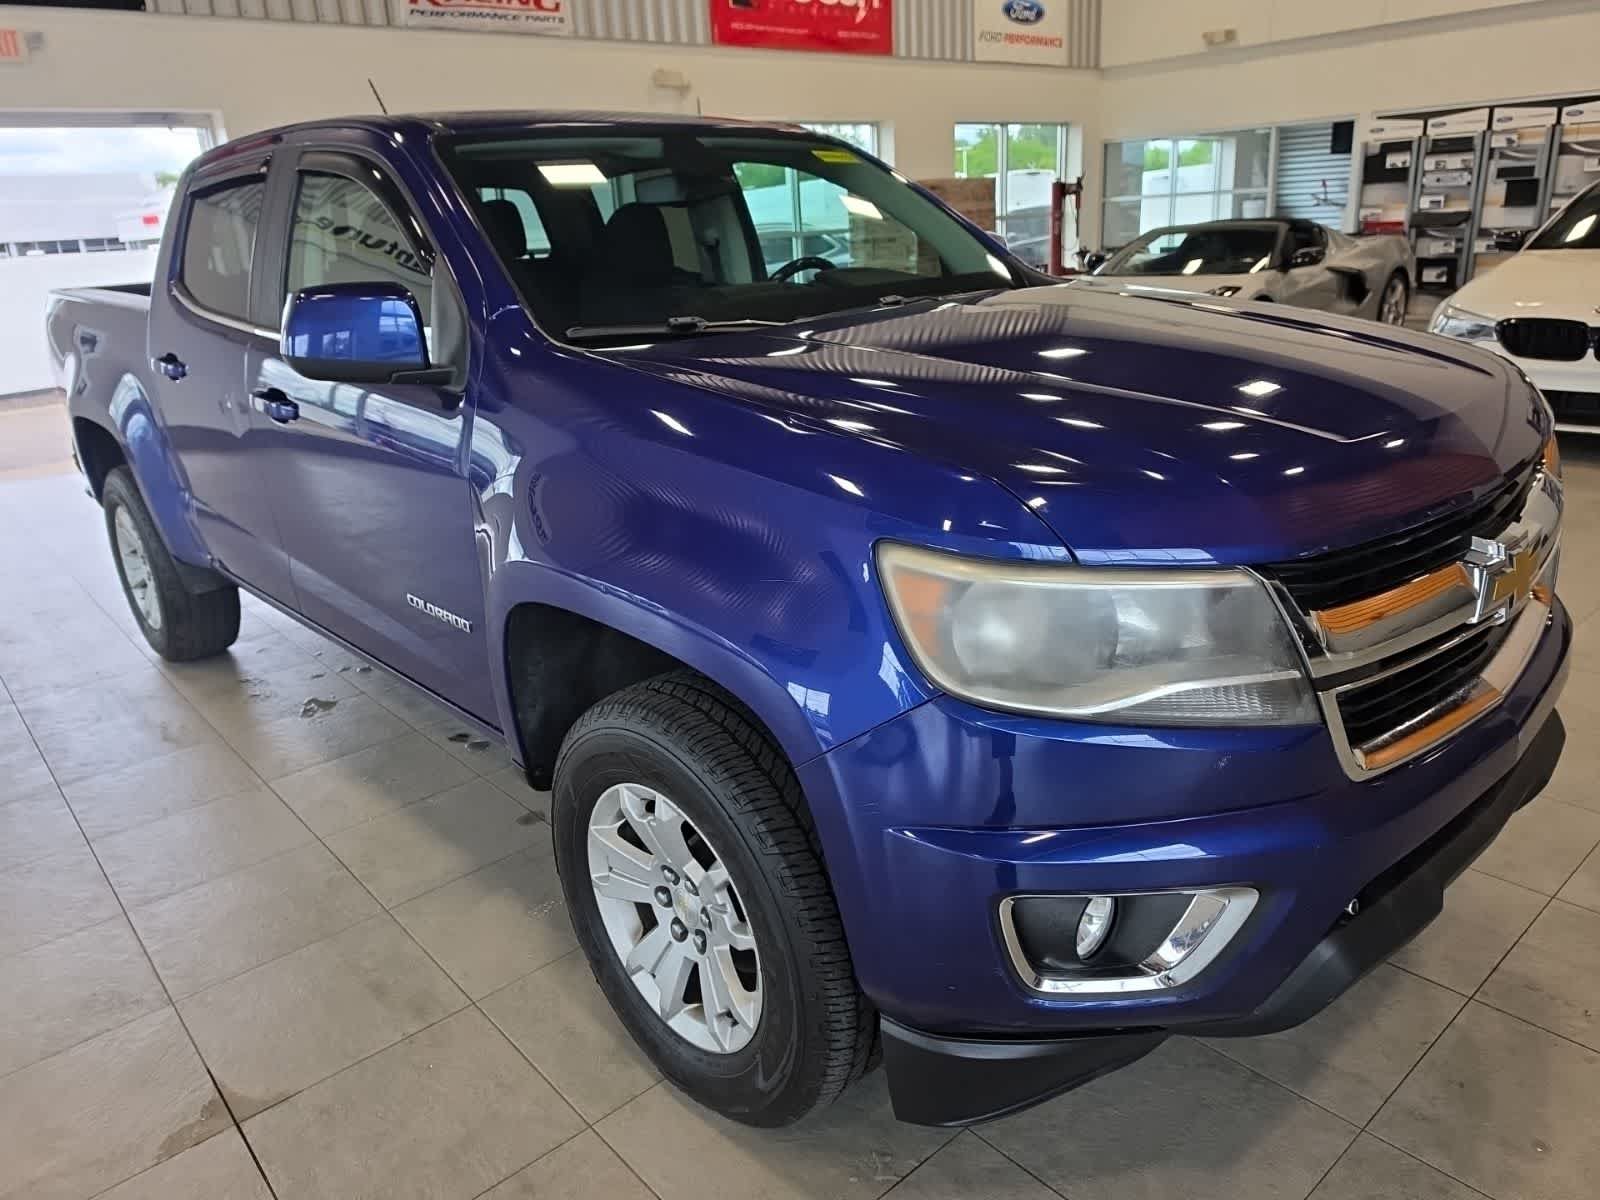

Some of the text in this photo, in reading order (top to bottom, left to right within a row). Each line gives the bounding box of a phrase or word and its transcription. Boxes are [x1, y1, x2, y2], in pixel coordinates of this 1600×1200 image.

[409, 9, 565, 24] PERFORMANCE PARTS
[1003, 32, 1063, 48] PERFORMANCE
[406, 593, 471, 633] COLORADO
